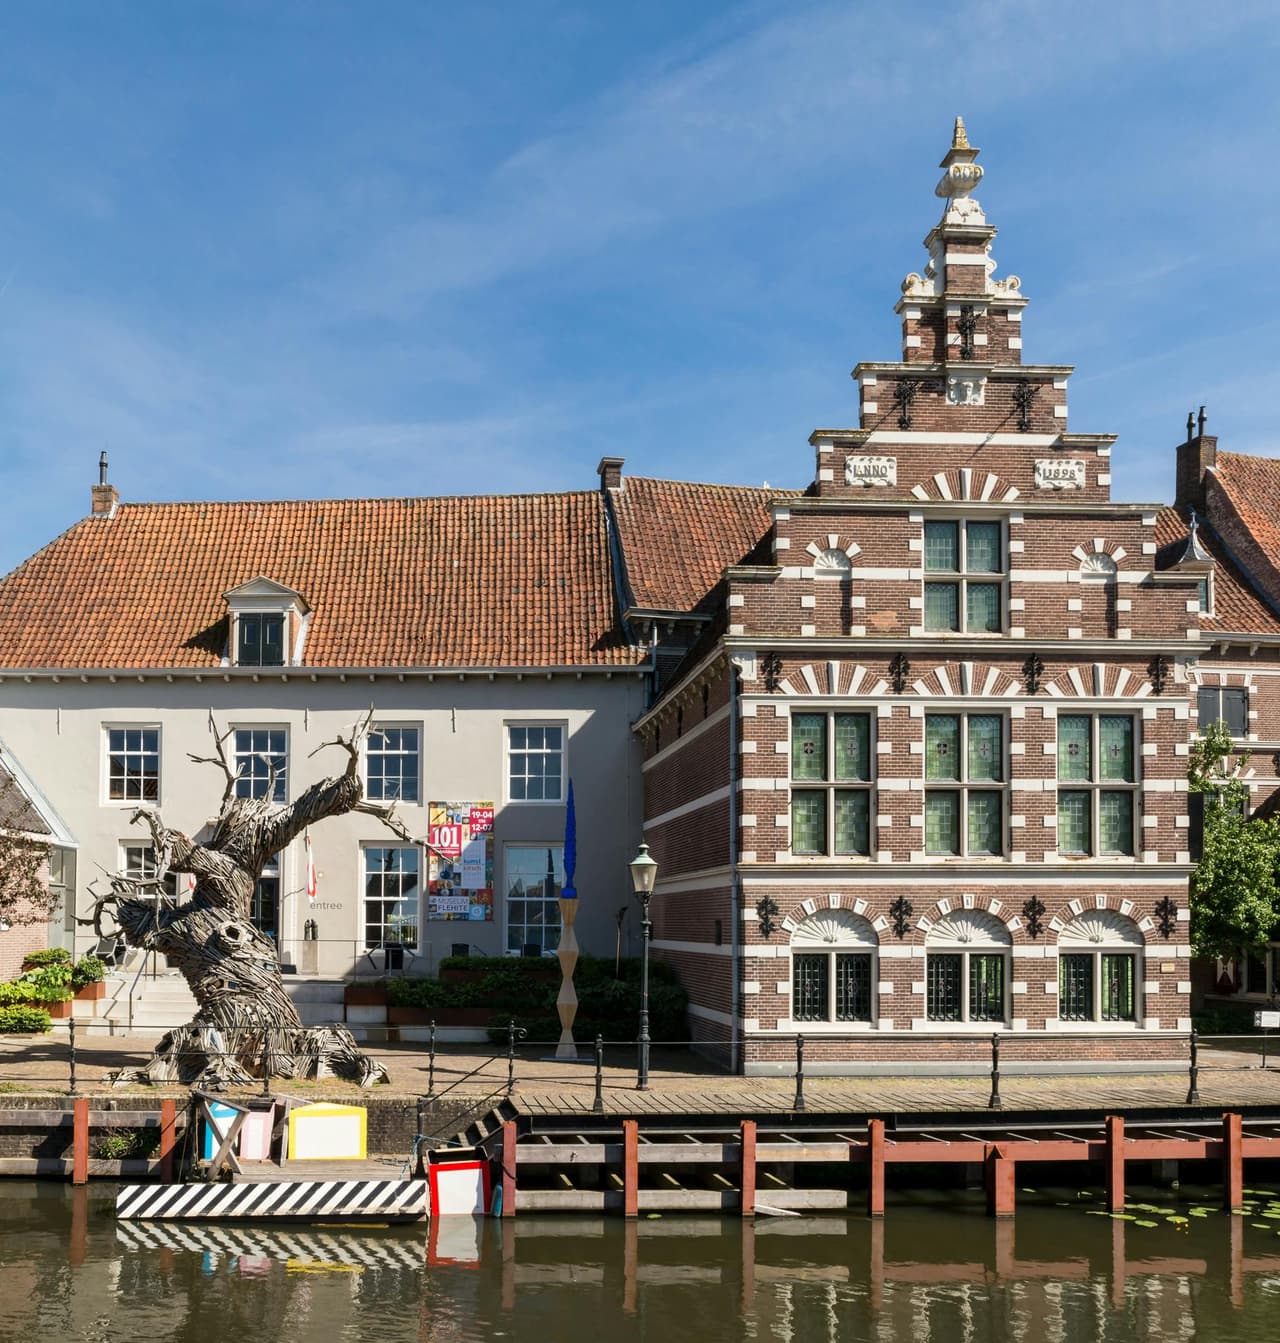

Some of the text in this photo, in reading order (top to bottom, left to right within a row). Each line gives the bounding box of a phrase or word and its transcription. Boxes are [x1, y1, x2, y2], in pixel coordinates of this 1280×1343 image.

[855, 464, 888, 477] ANNO
[1047, 468, 1076, 479] 1898
[432, 826, 460, 848] 101
[310, 901, 343, 910] entree
